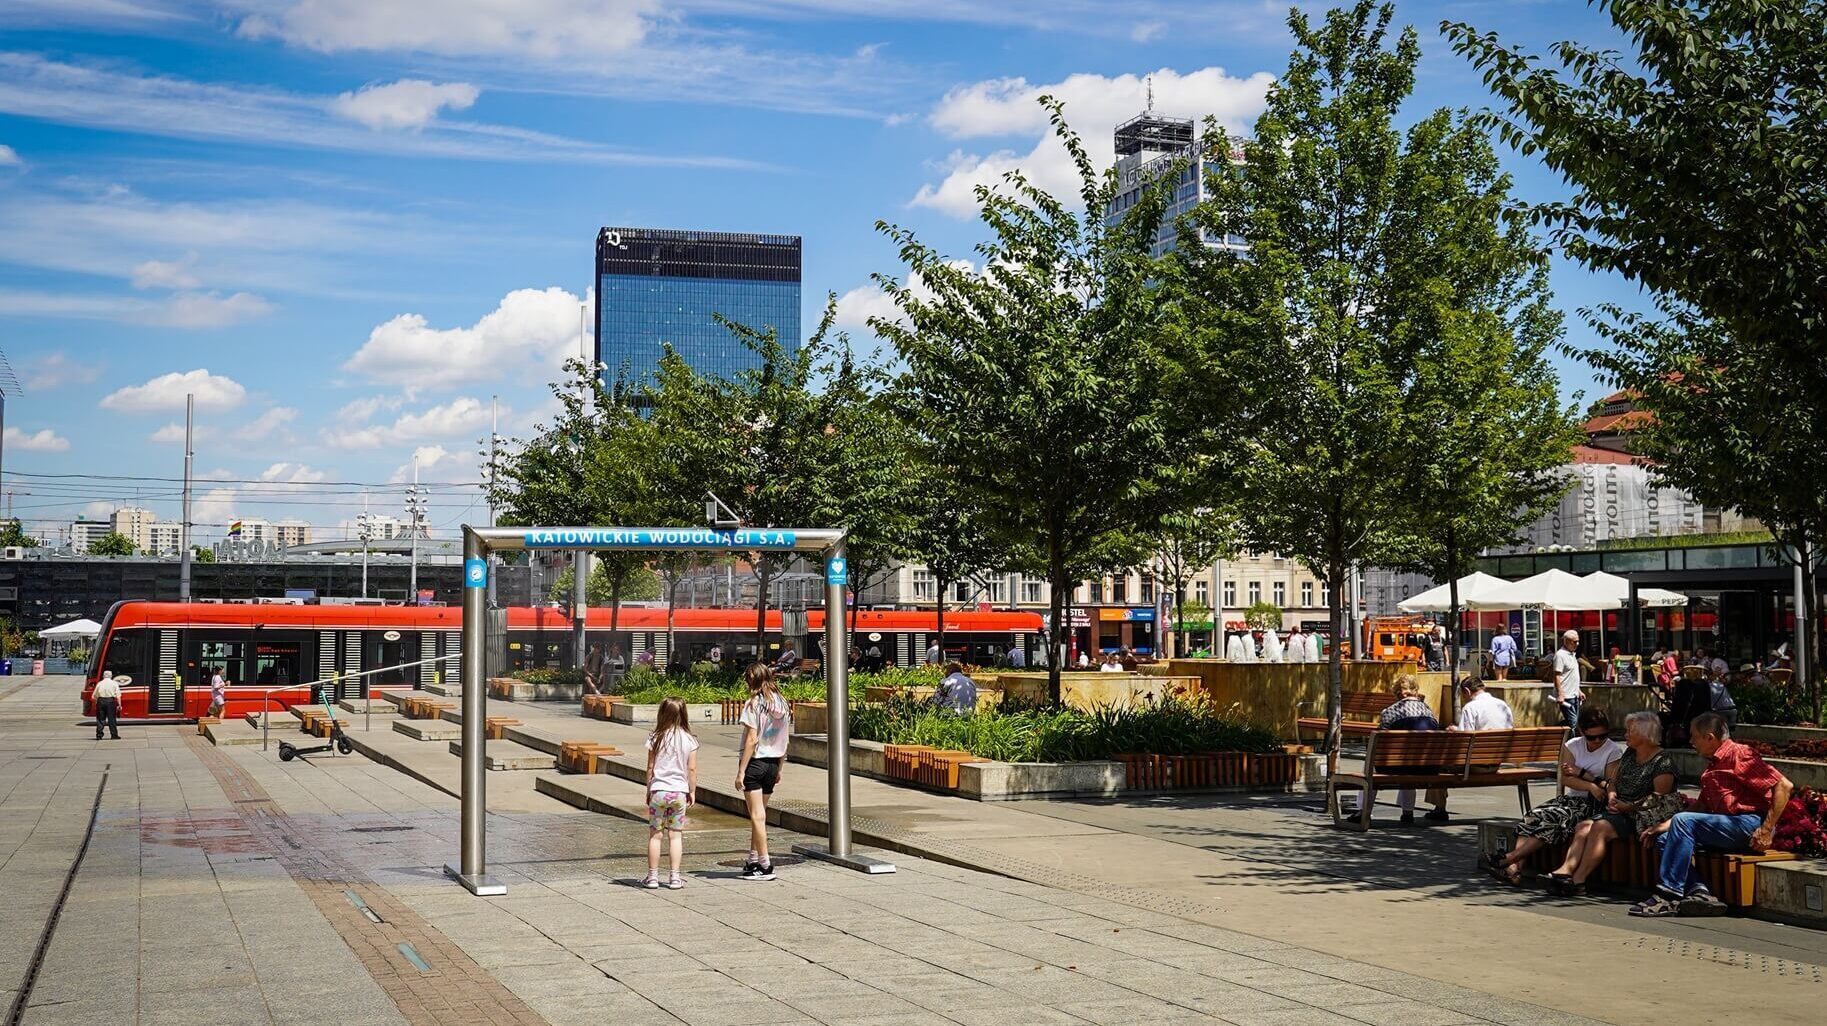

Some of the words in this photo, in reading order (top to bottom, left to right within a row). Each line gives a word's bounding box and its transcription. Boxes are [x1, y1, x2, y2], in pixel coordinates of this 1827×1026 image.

[1606, 465, 1618, 540] PTOLITH
[532, 531, 640, 544] KATOWICKIE
[649, 531, 750, 546] WODOCIĄGI
[759, 532, 791, 545] S.A.
